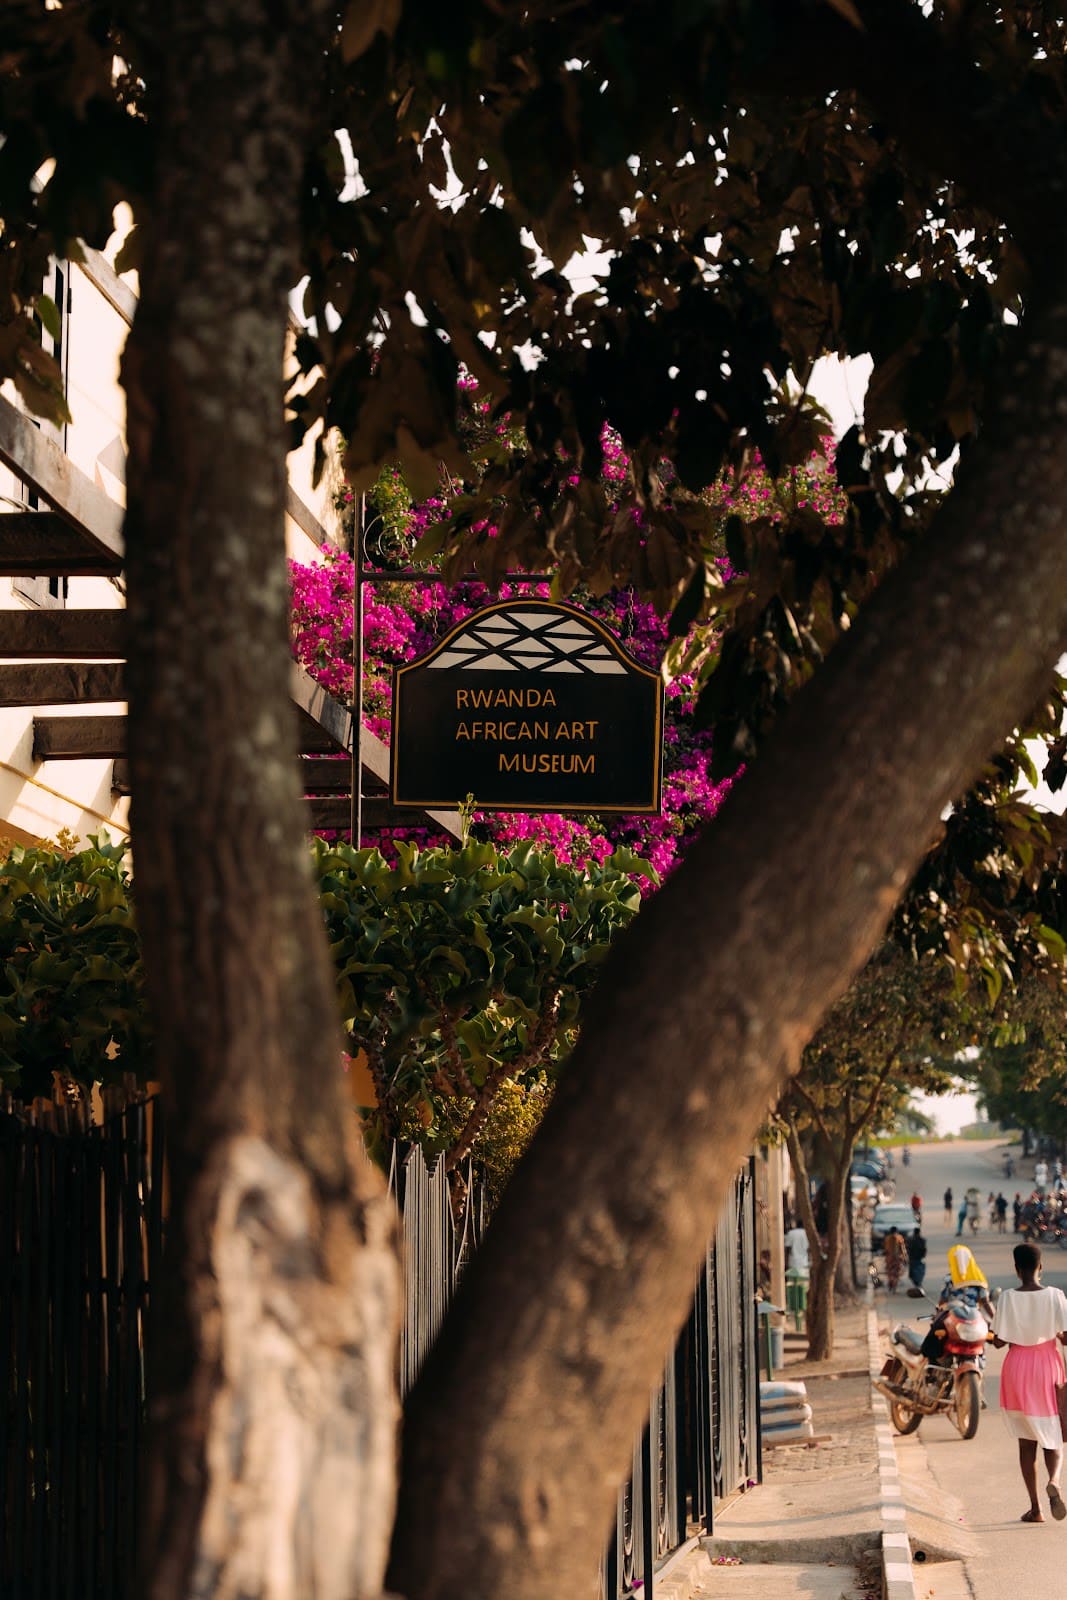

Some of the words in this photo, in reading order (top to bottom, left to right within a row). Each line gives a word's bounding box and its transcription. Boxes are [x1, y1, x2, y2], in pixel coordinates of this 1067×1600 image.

[456, 688, 557, 710] RWANDA
[455, 721, 549, 741] AFRICAN
[555, 720, 599, 741] ART
[499, 753, 595, 774] MUSEUM
